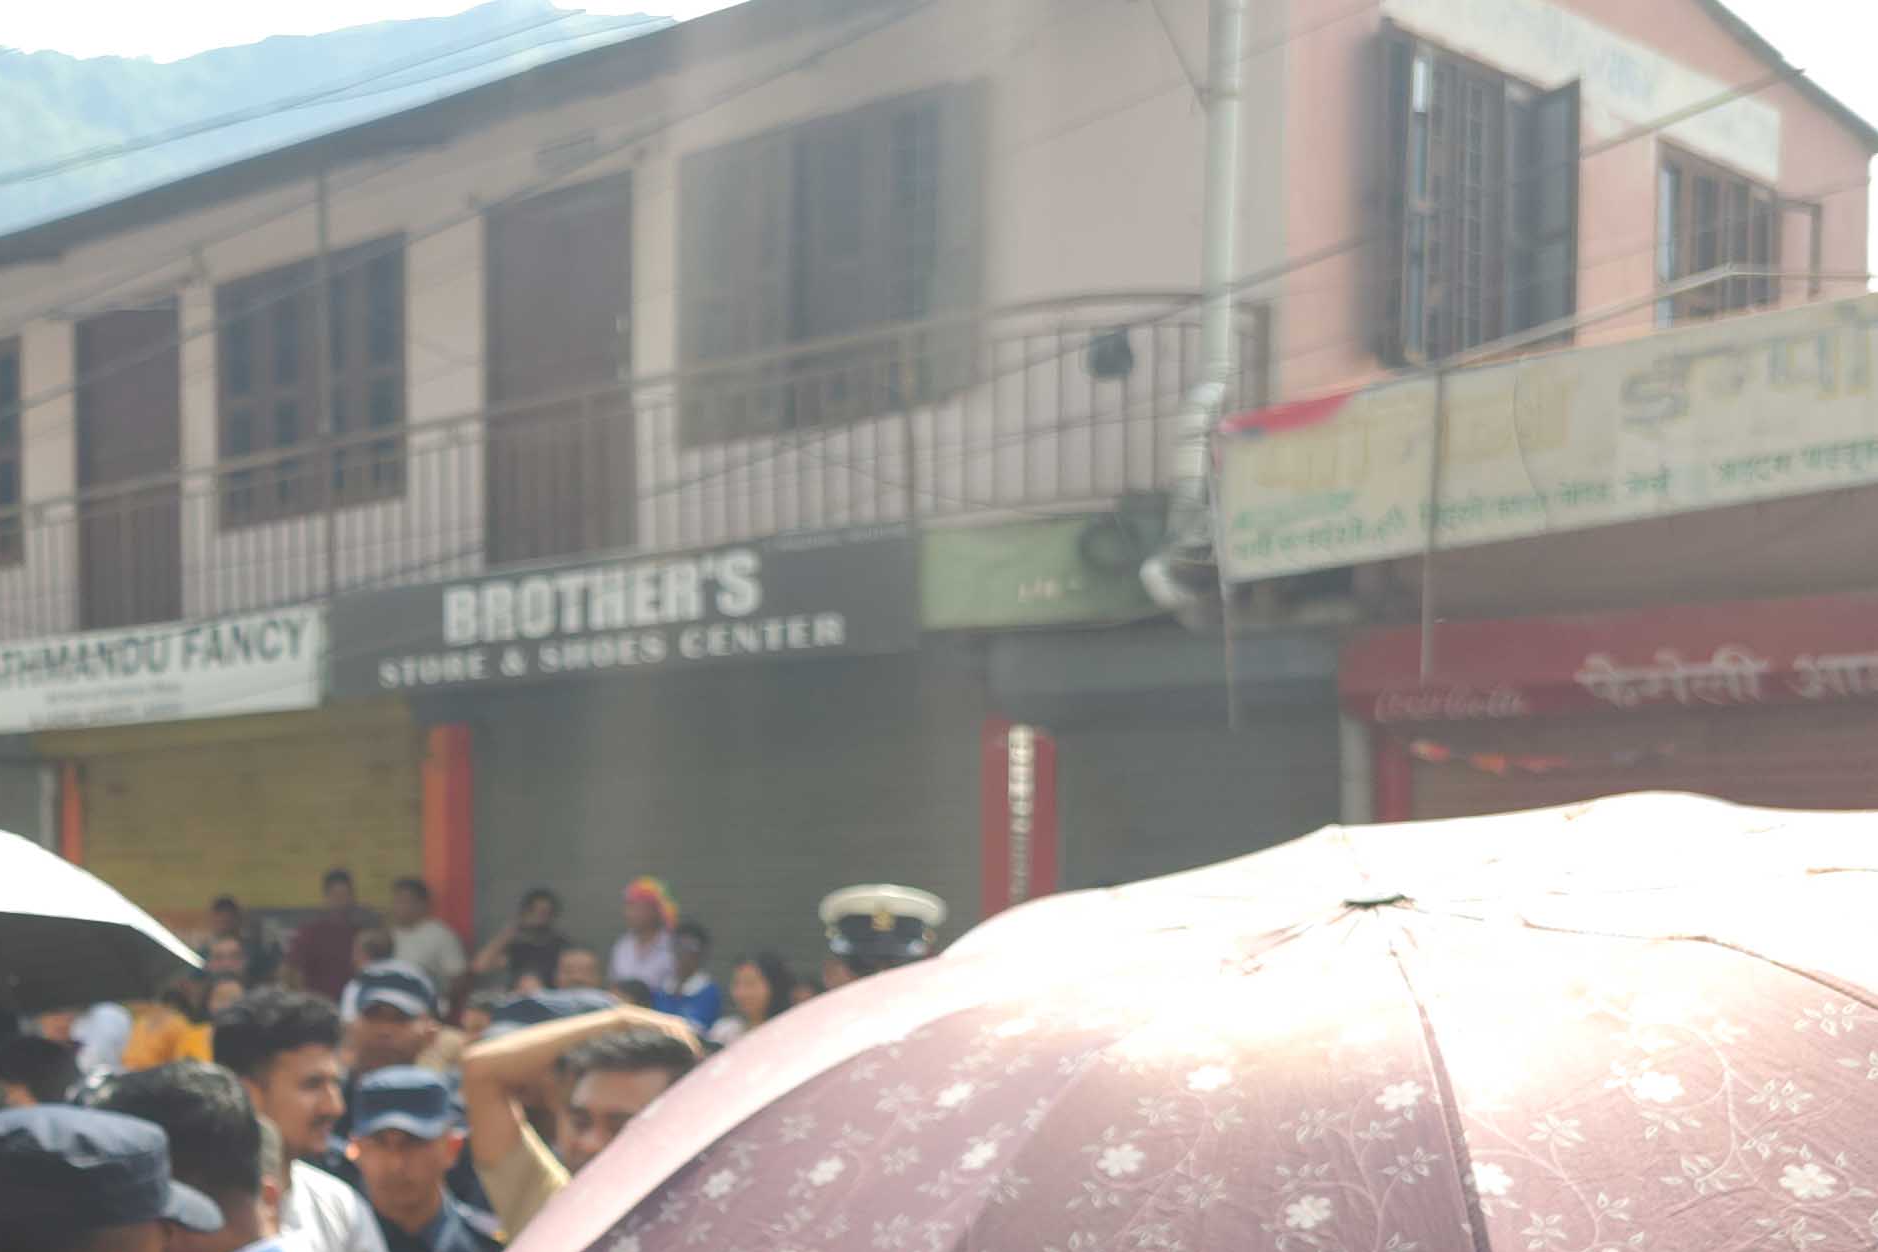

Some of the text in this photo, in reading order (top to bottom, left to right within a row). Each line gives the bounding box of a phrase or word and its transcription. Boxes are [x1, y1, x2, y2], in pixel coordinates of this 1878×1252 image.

[444, 548, 763, 646] BROTHER'S
[180, 618, 309, 672] FANCY
[378, 612, 847, 688] STORE & SHOES CENTER
